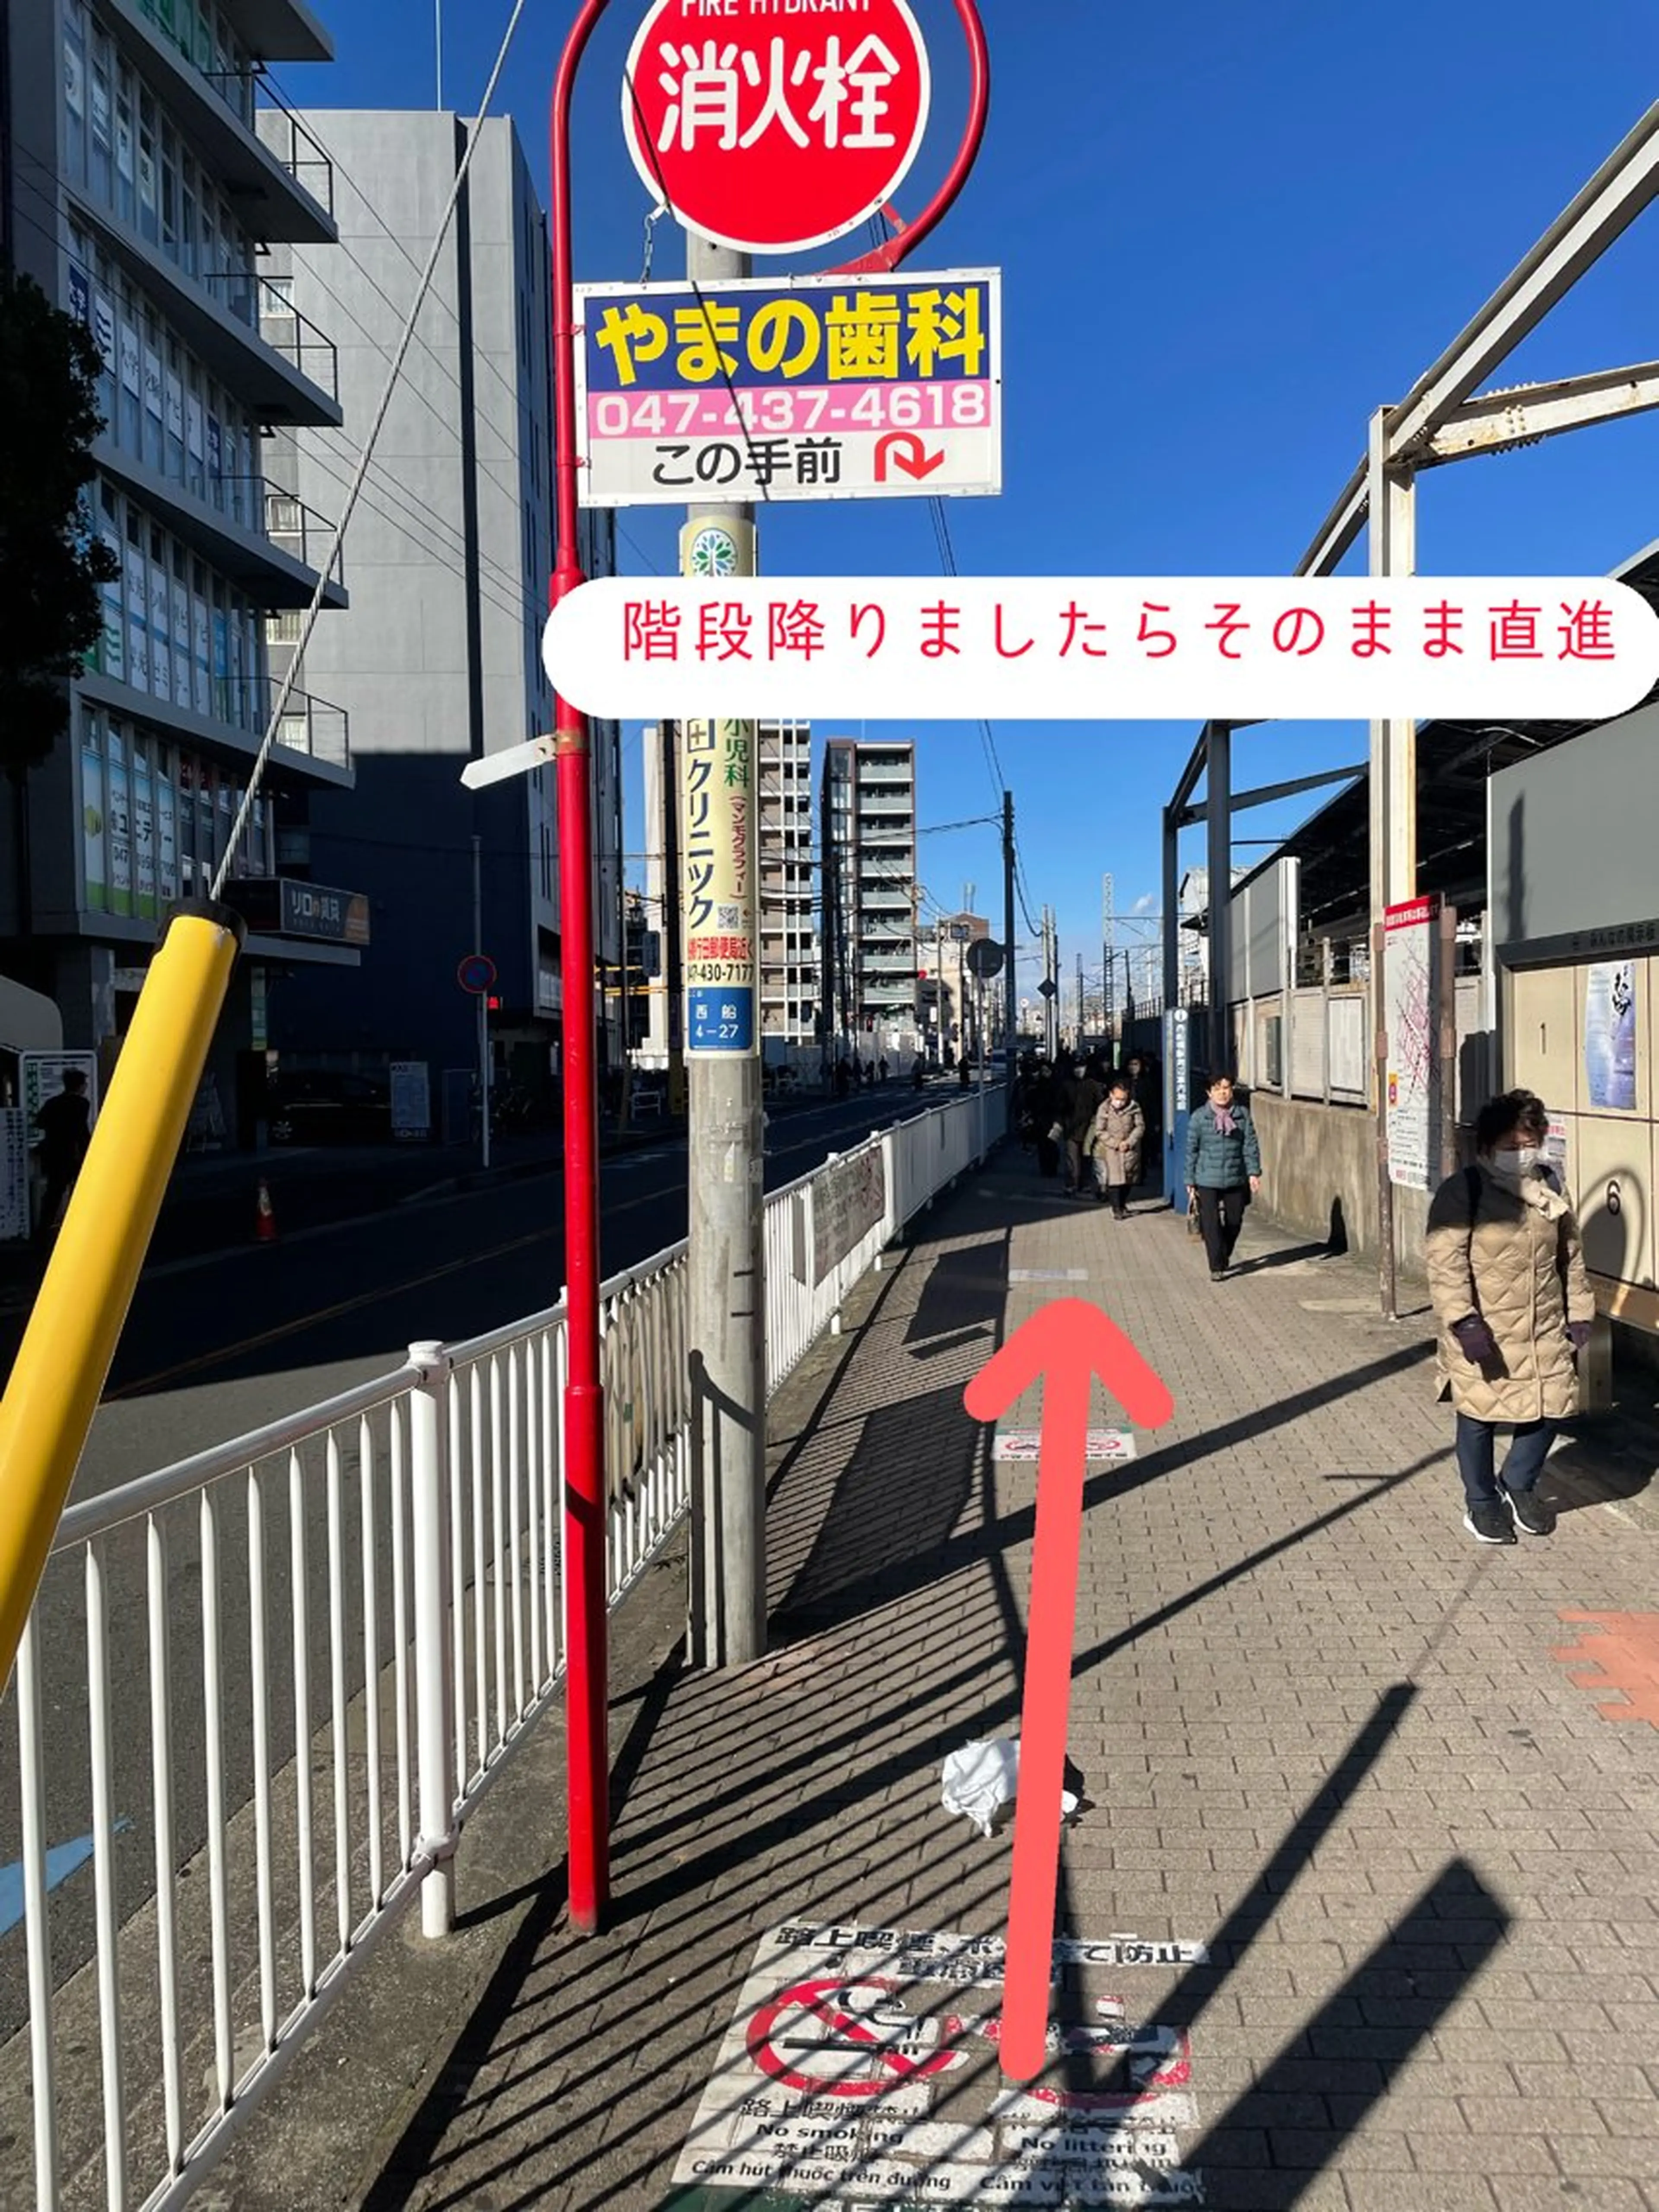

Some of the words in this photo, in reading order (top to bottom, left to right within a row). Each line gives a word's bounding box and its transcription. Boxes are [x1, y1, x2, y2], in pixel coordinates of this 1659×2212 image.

[658, 34, 899, 152] 消火栓
[597, 288, 984, 385] やまの歯科
[597, 385, 985, 436] 047-437-4618
[653, 437, 842, 486] この手前
[1605, 1180, 1621, 1215] 6
[756, 2124, 789, 2137] No
[796, 2128, 904, 2145] smokng
[1021, 2139, 1054, 2151] No
